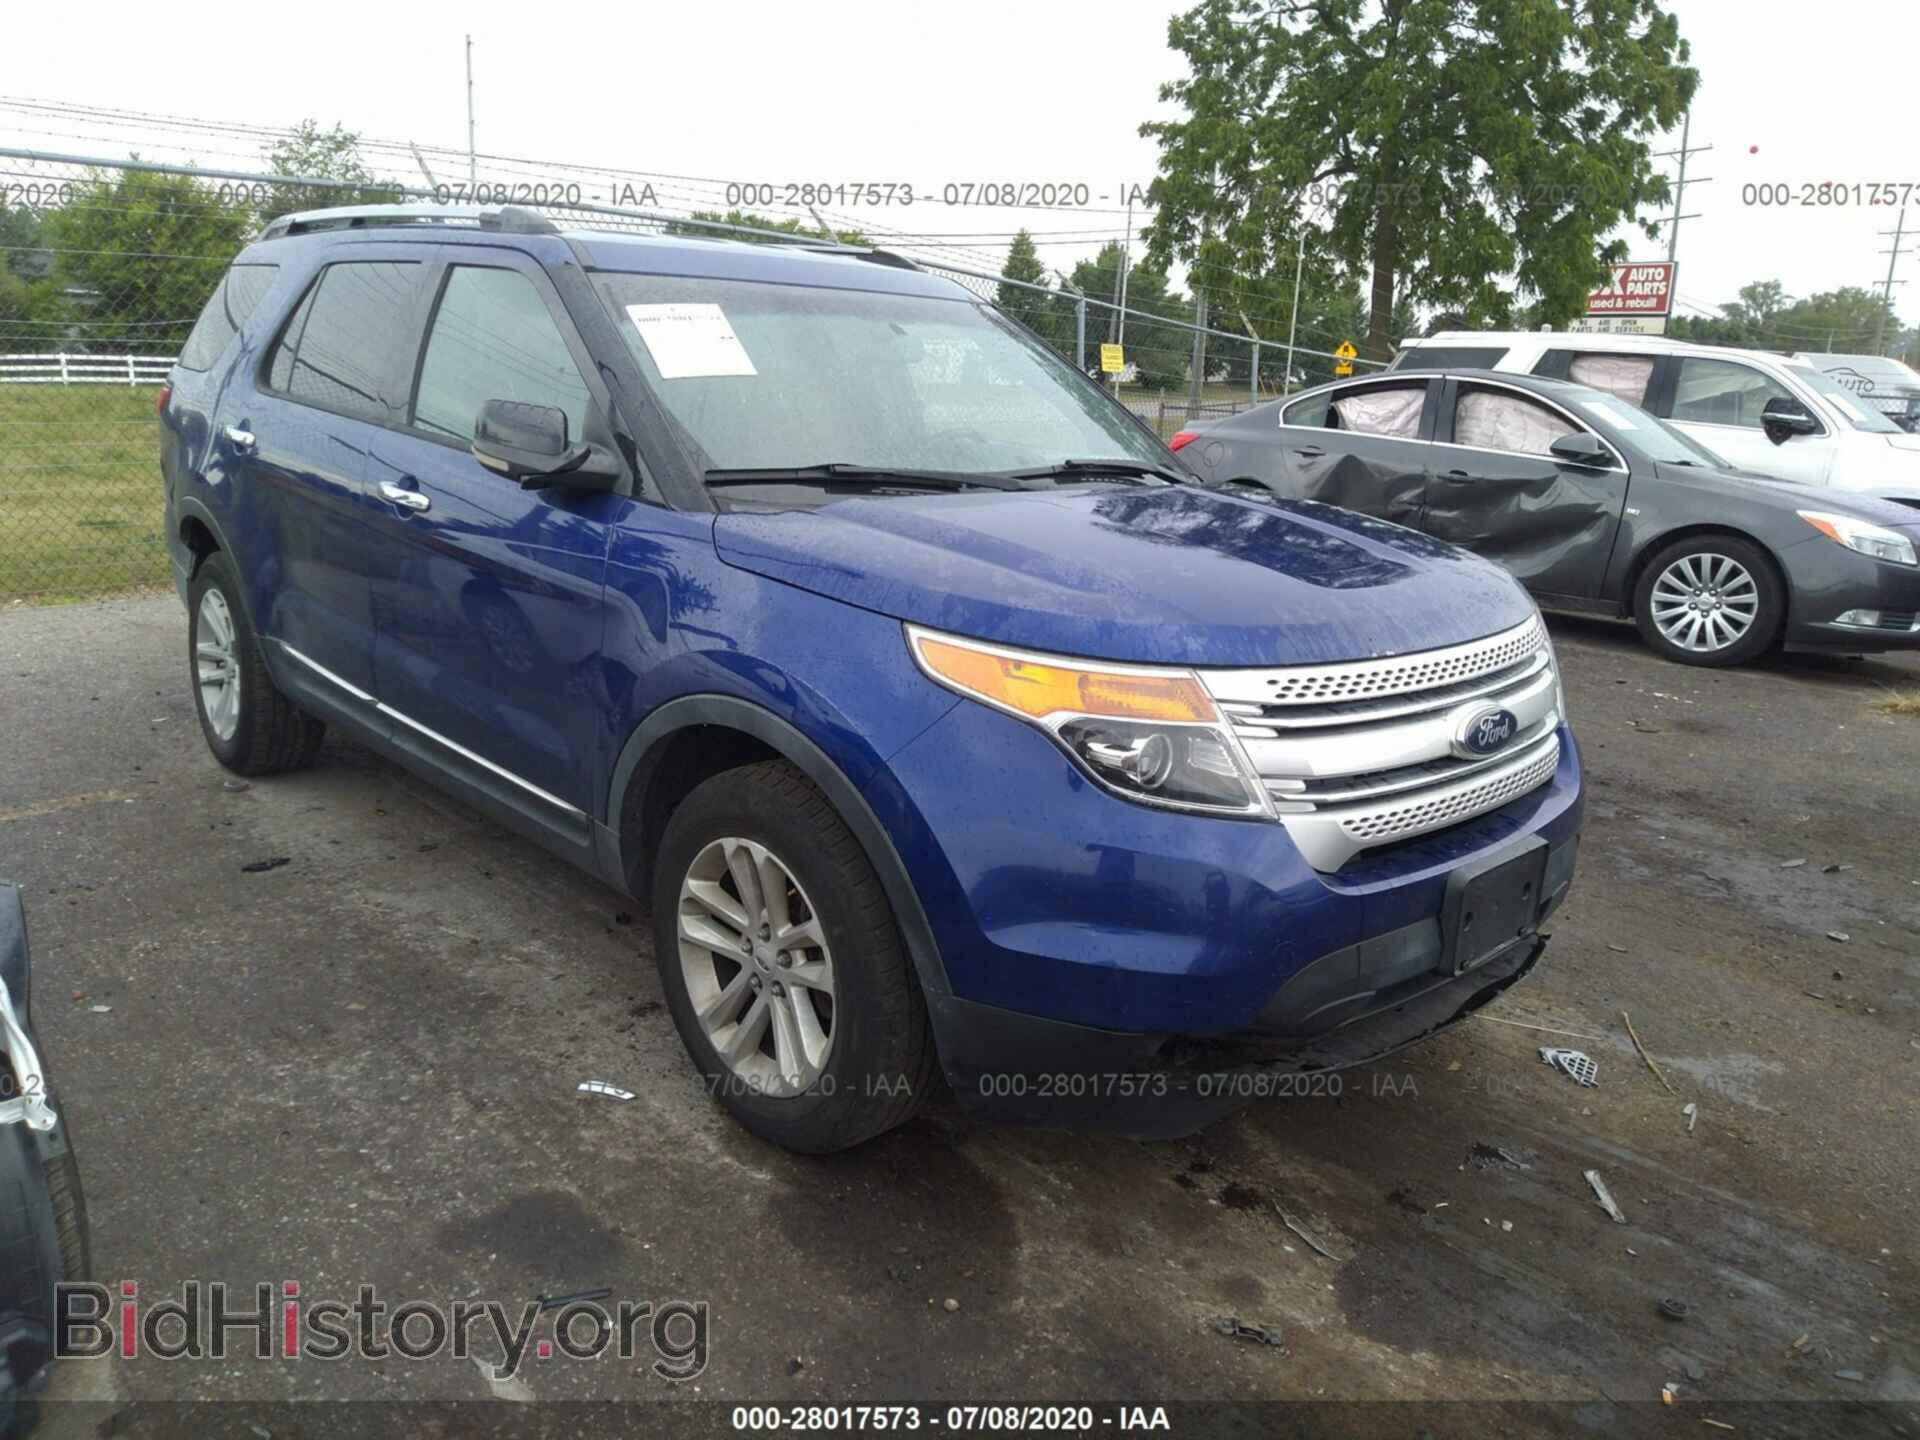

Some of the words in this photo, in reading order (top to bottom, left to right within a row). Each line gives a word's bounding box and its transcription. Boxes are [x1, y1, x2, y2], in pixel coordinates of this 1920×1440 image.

[1628, 268, 1664, 281] AUTO
[1626, 282, 1667, 295] PARTS
[1590, 297, 1614, 308] used
[1616, 297, 1625, 308] &
[1626, 297, 1657, 308] rebuilt
[1478, 713, 1510, 747] Ford
